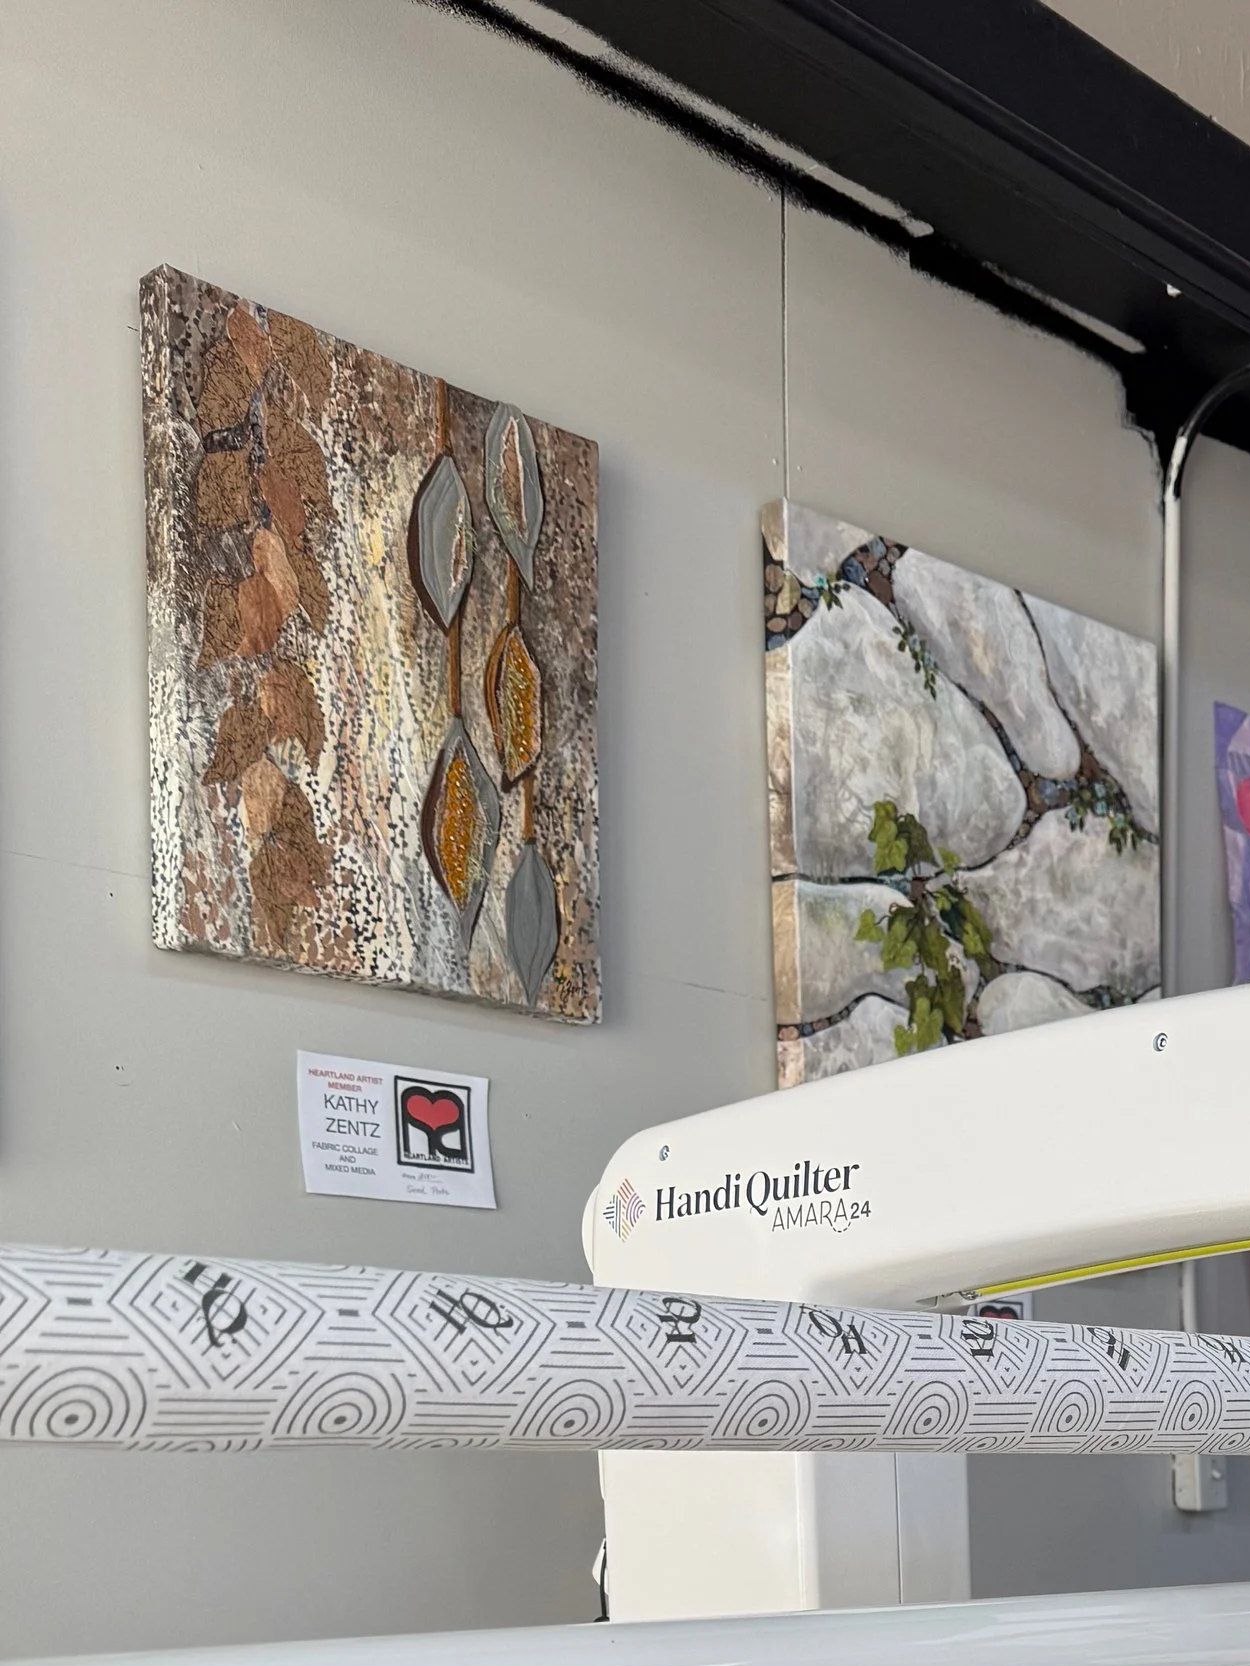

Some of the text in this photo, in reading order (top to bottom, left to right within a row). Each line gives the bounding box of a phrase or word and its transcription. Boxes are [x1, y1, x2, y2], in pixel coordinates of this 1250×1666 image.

[308, 1069, 383, 1085] HEARTLAND ARTIST
[327, 1081, 363, 1093] MEMBER
[324, 1094, 378, 1114] KATHY
[326, 1117, 381, 1138] ZENTZ
[312, 1141, 378, 1155] FABRIC COLLAGE
[340, 1155, 356, 1163] AND
[403, 1152, 441, 1161] HEARTLAND
[324, 1164, 376, 1175] MIXED MEDIA
